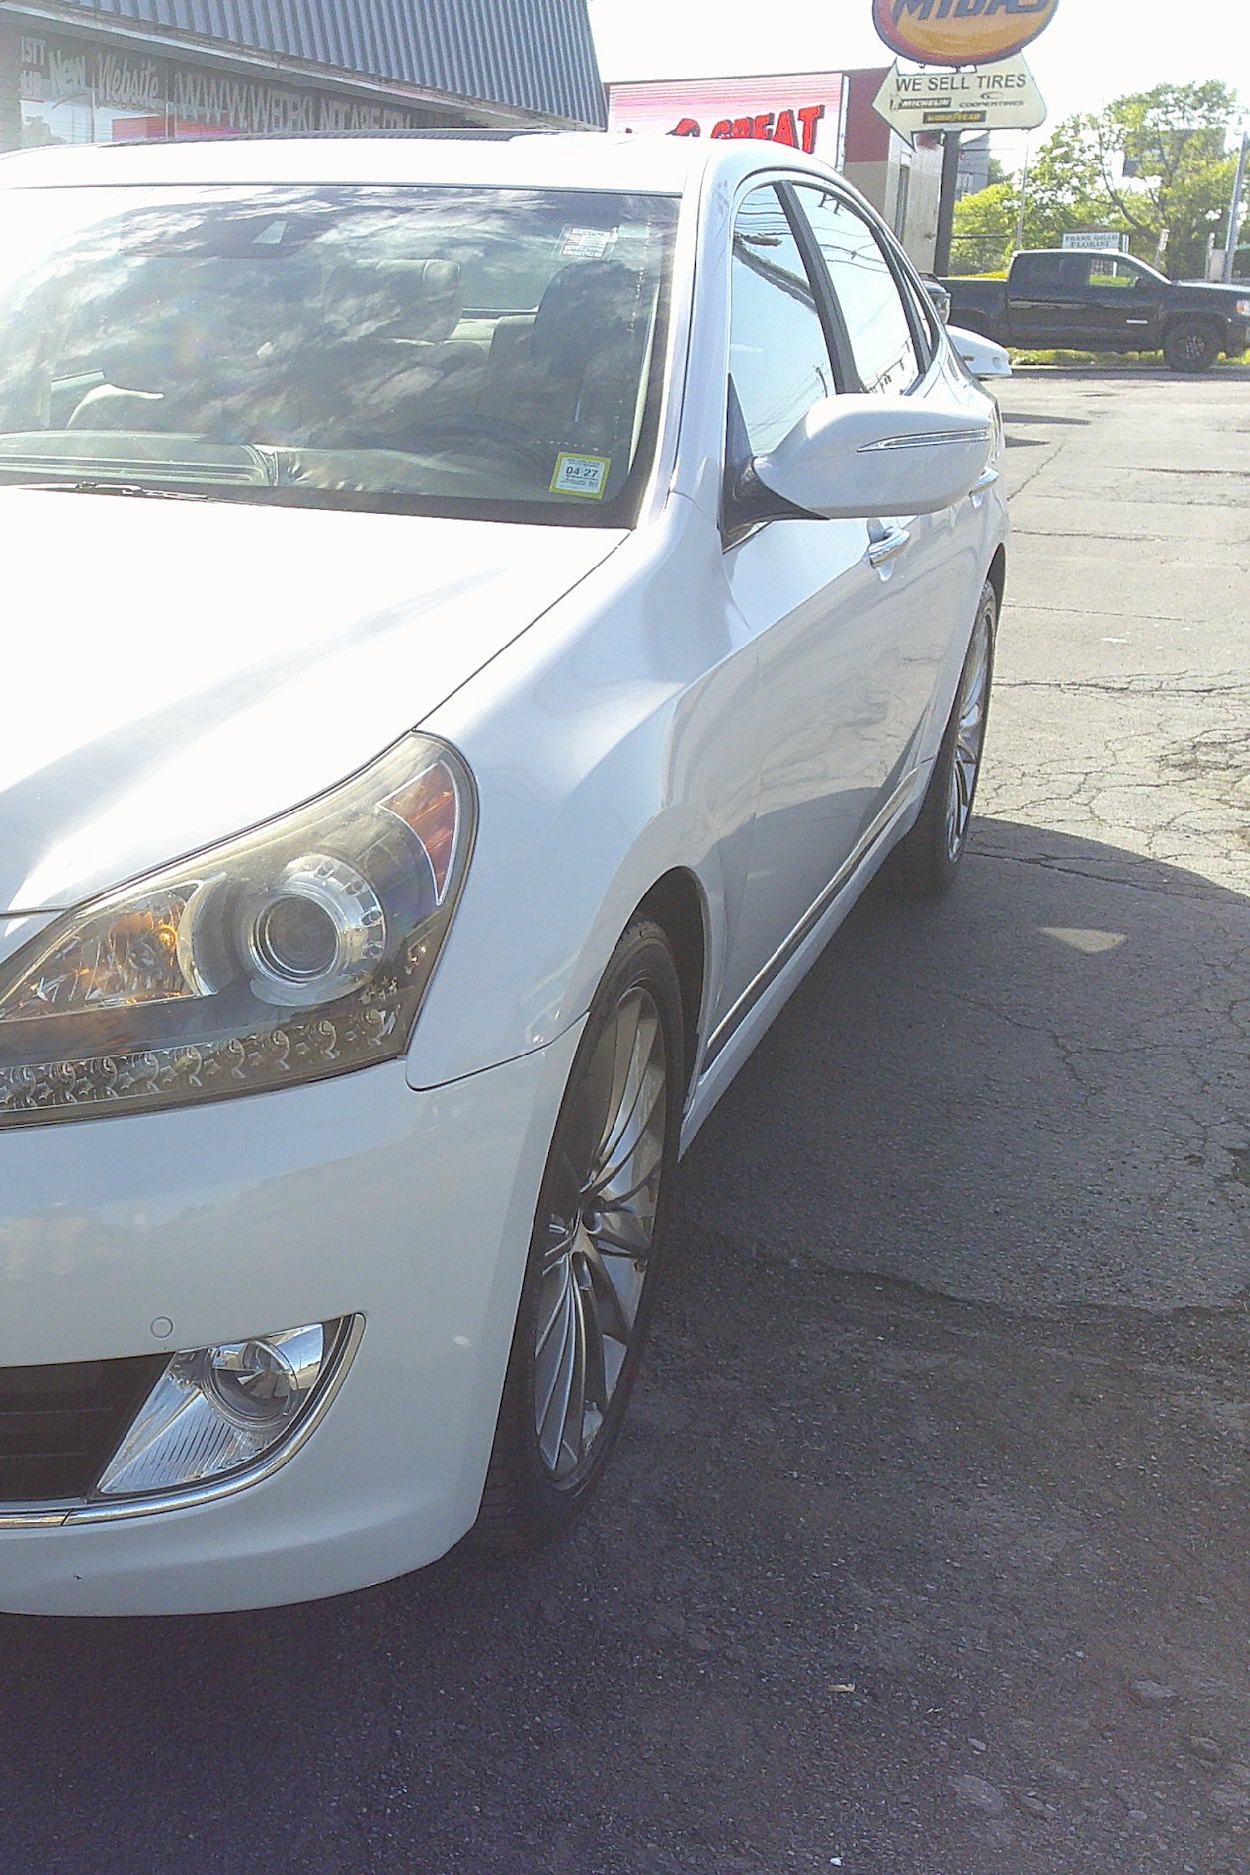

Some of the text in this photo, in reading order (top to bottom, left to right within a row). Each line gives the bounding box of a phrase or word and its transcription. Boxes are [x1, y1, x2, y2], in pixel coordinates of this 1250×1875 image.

[895, 74, 1026, 92] WE SELL TIRES
